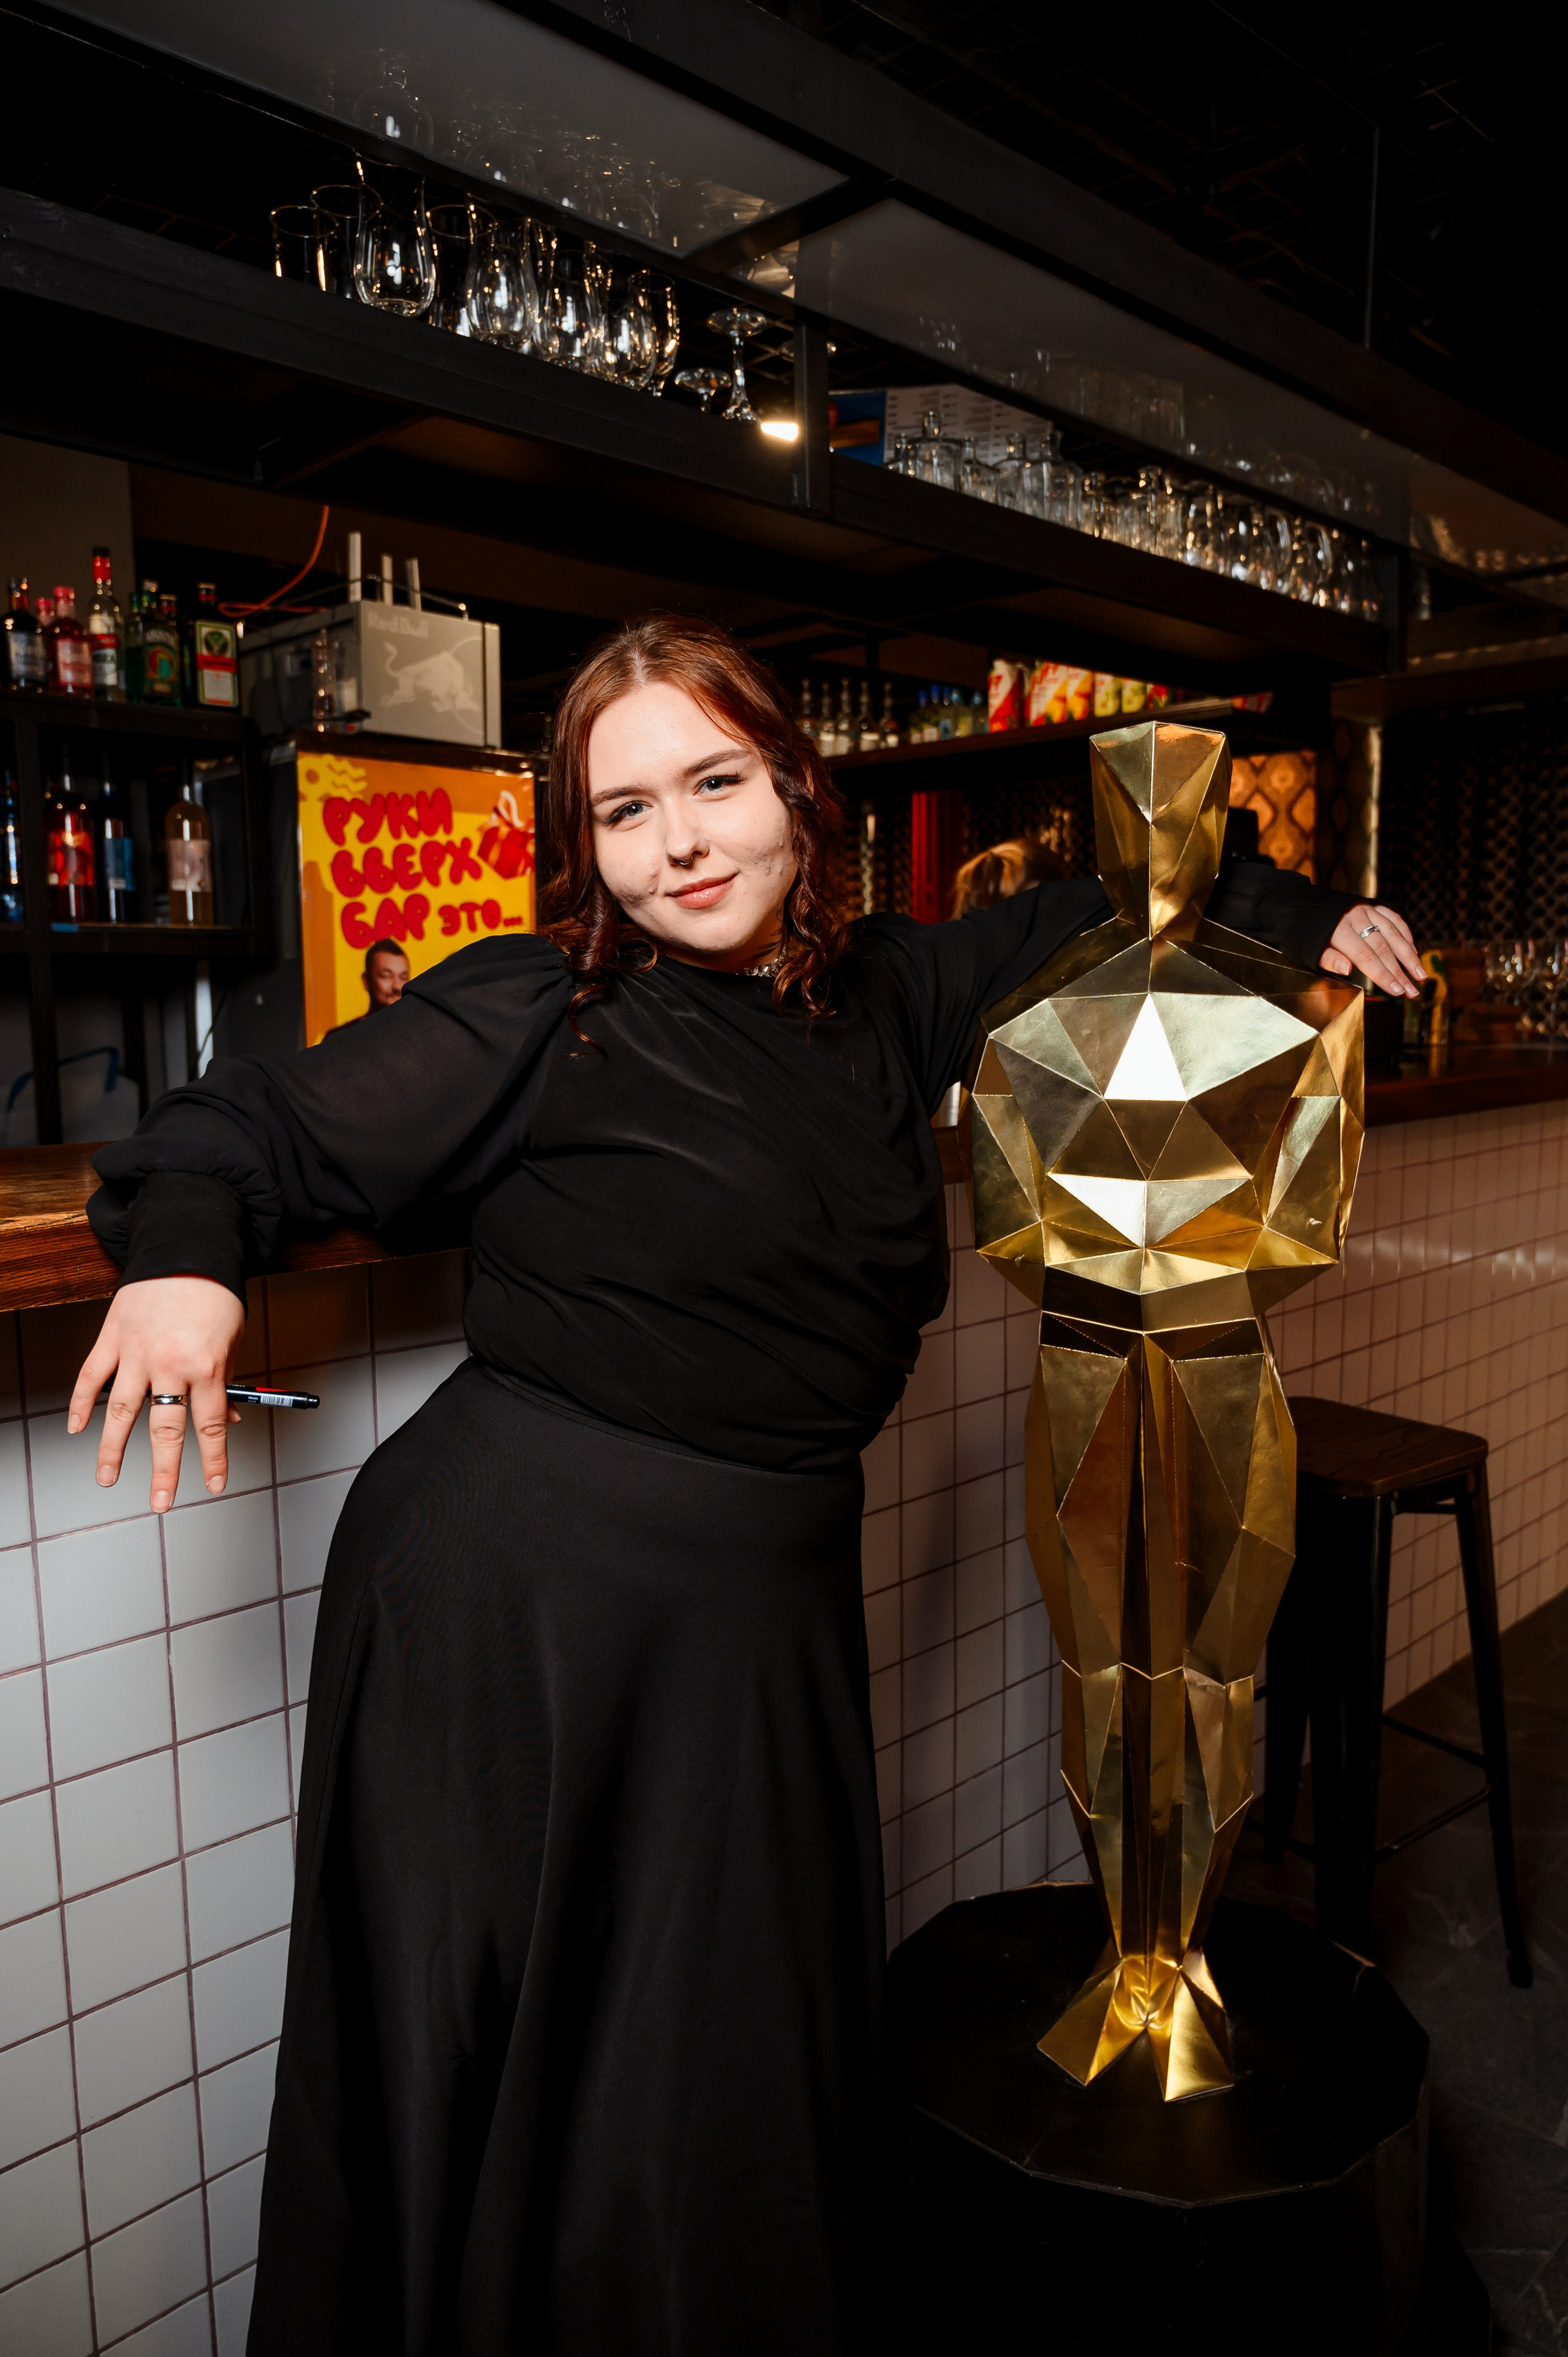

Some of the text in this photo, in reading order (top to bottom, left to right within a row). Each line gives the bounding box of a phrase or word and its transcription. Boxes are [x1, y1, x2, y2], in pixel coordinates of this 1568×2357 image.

[323, 789, 453, 846] РУКИ
[331, 837, 482, 898] ВВЕРХ
[341, 893, 430, 949] БАР
